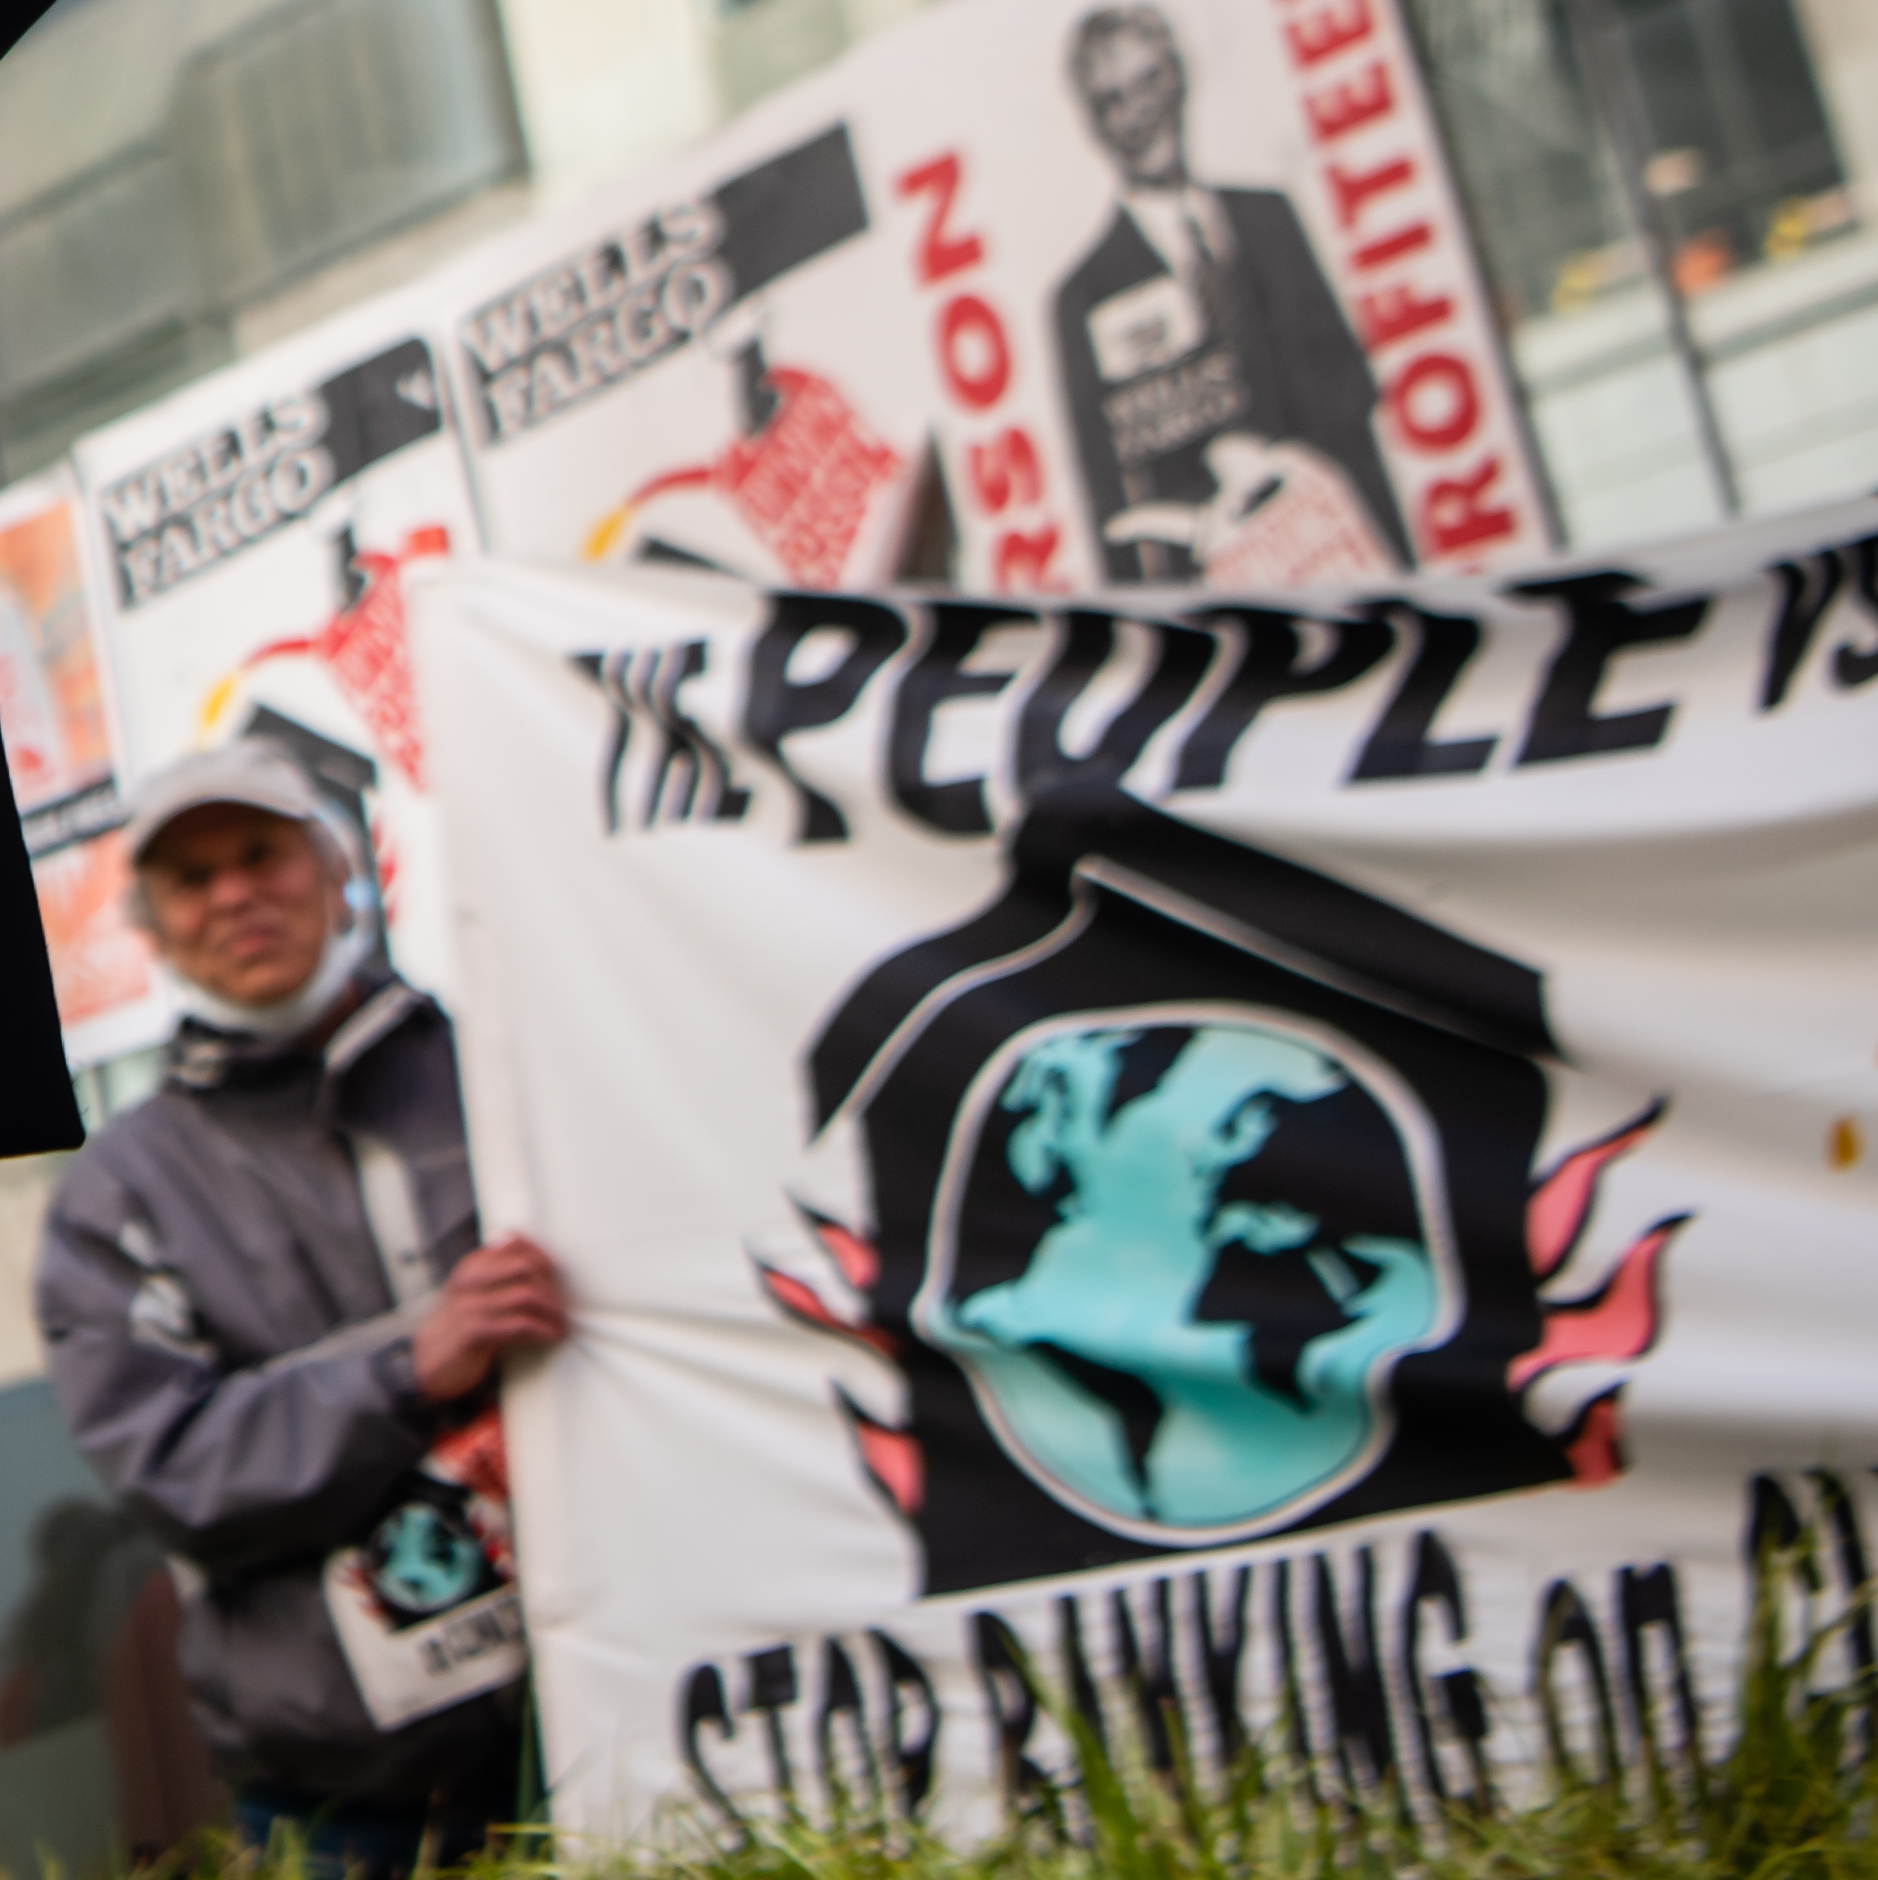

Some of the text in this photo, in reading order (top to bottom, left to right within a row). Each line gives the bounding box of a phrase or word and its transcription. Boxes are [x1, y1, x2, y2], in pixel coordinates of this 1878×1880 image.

[462, 197, 724, 373] WELLS
[488, 257, 735, 440] FARGO
[891, 149, 1072, 594] RSON
[98, 376, 330, 548] WELLS
[120, 443, 336, 606] FARGO
[567, 638, 753, 835] THE
[748, 572, 1719, 845] PEOPLE
[682, 1626, 939, 1846] STOP
